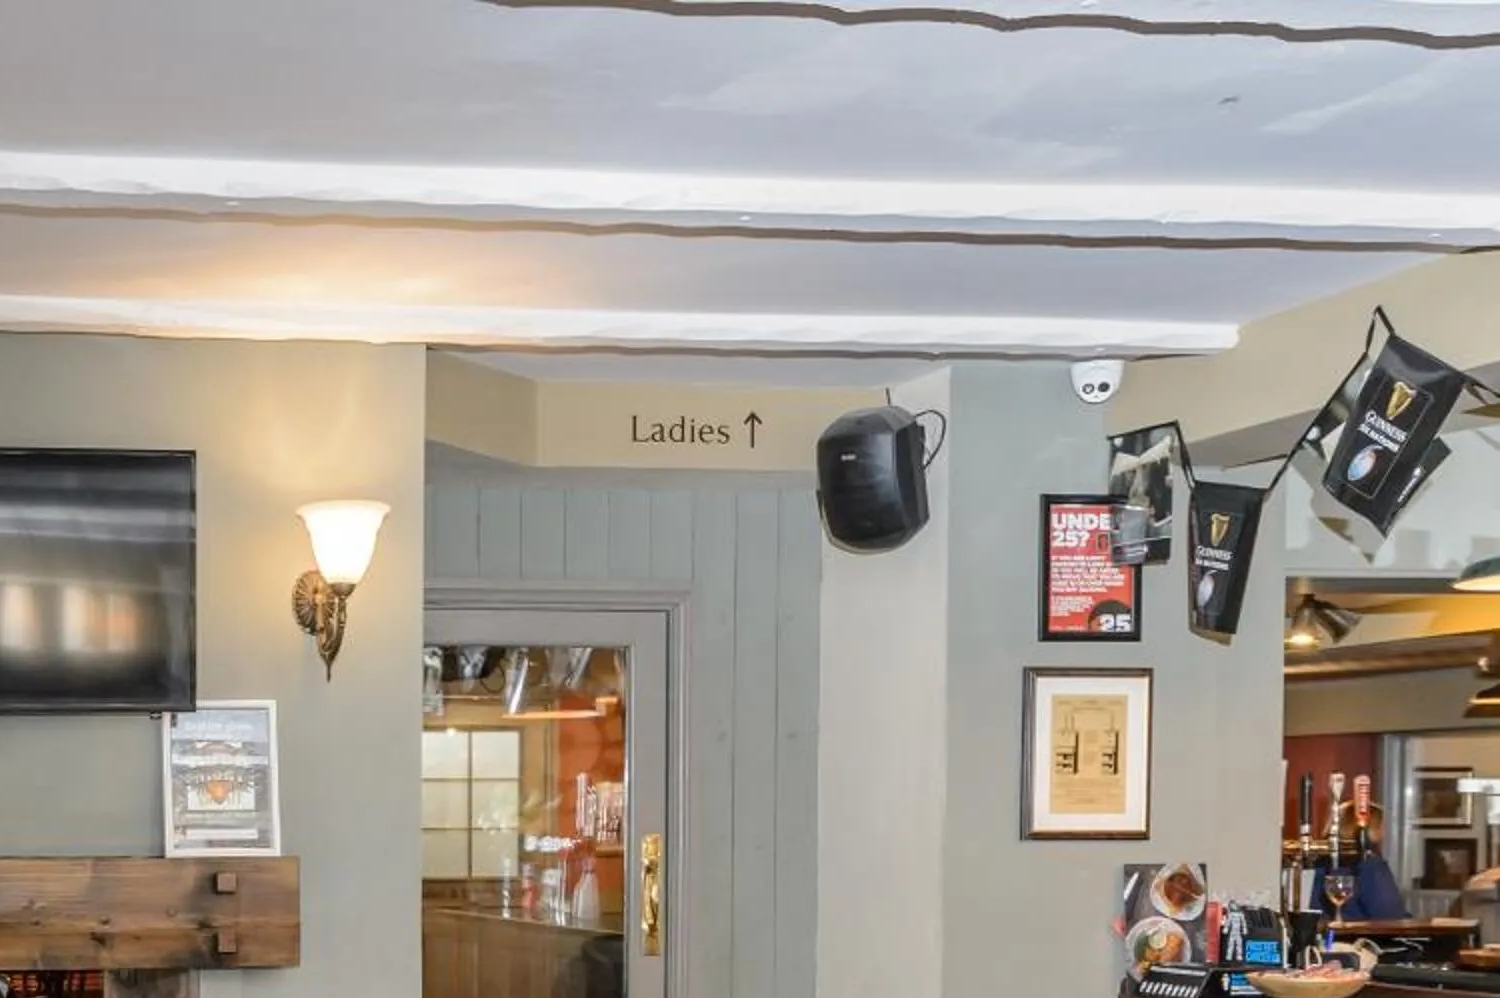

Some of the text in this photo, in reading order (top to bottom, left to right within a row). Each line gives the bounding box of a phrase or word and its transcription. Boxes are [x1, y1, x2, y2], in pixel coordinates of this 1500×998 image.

[631, 414, 731, 445] Ladies
[1051, 512, 1111, 531] UNDE
[1052, 530, 1091, 549] 25?
[1100, 613, 1133, 632] 25
